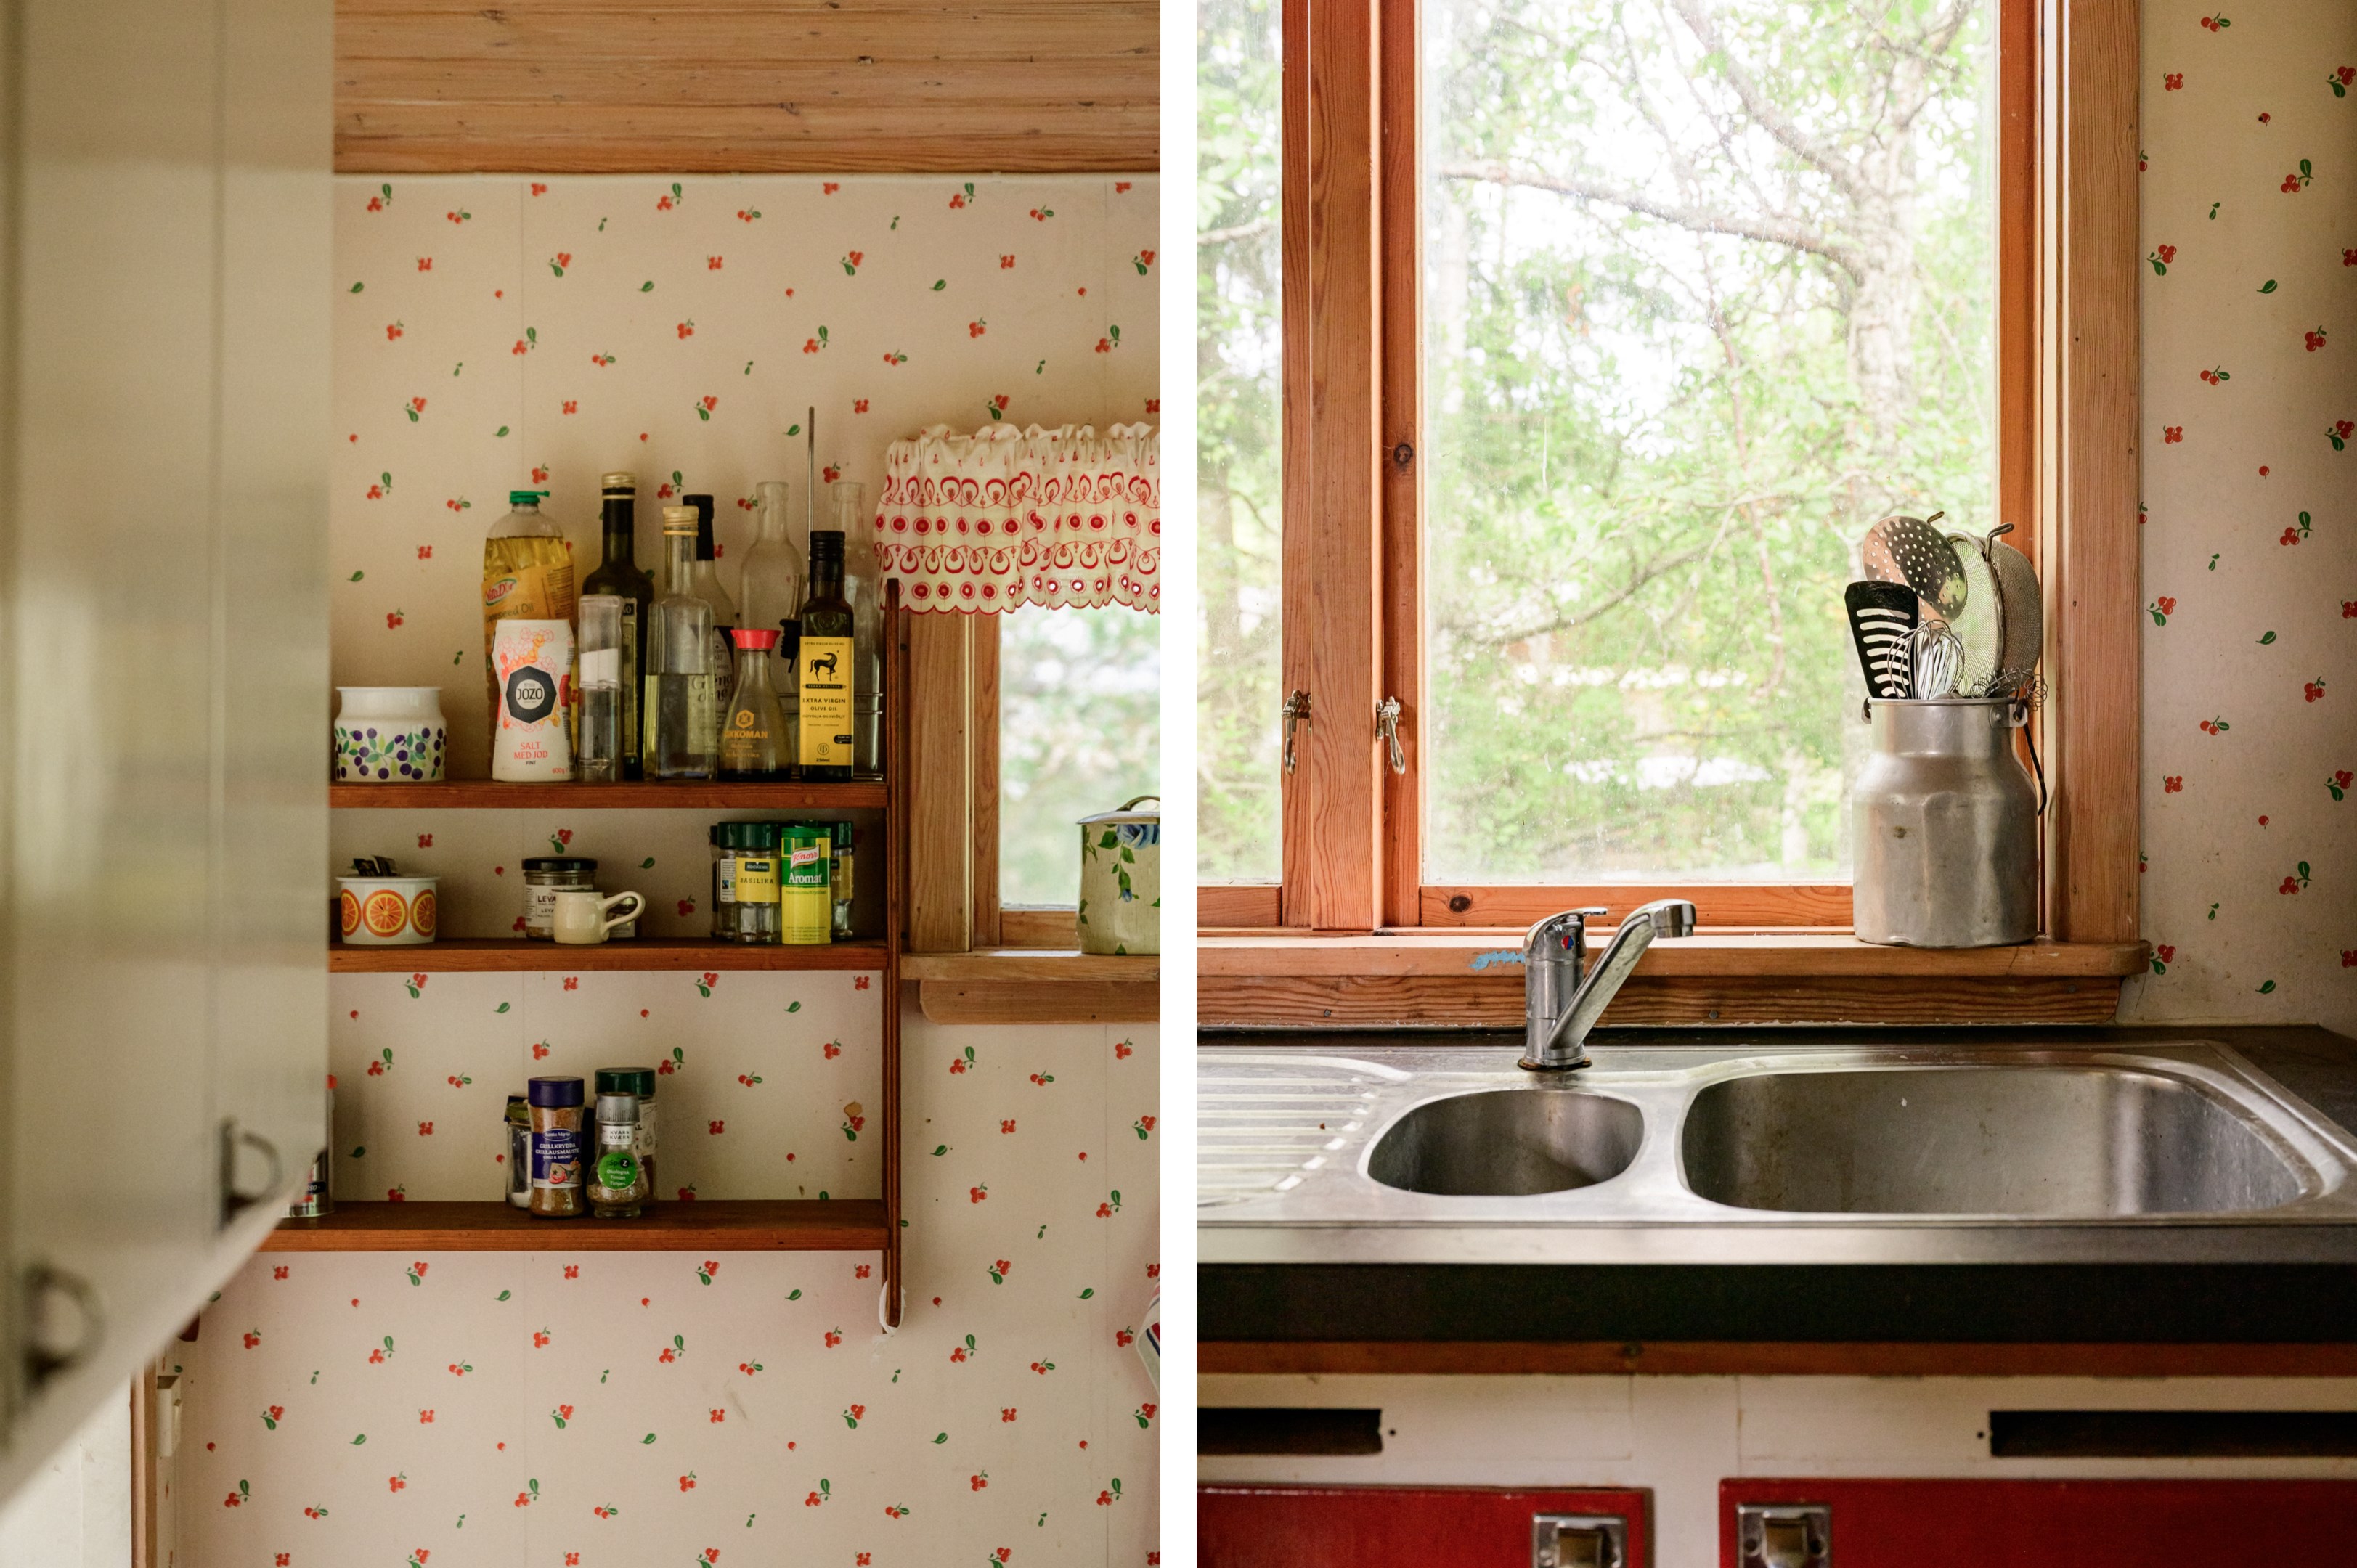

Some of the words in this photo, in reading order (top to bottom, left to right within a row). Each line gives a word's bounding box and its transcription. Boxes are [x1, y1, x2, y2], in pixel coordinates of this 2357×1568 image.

[521, 603, 534, 613] Oil
[520, 741, 541, 750] SALT
[532, 750, 548, 759] JOD
[792, 849, 818, 863] Knorr
[789, 873, 822, 883] Aromat
